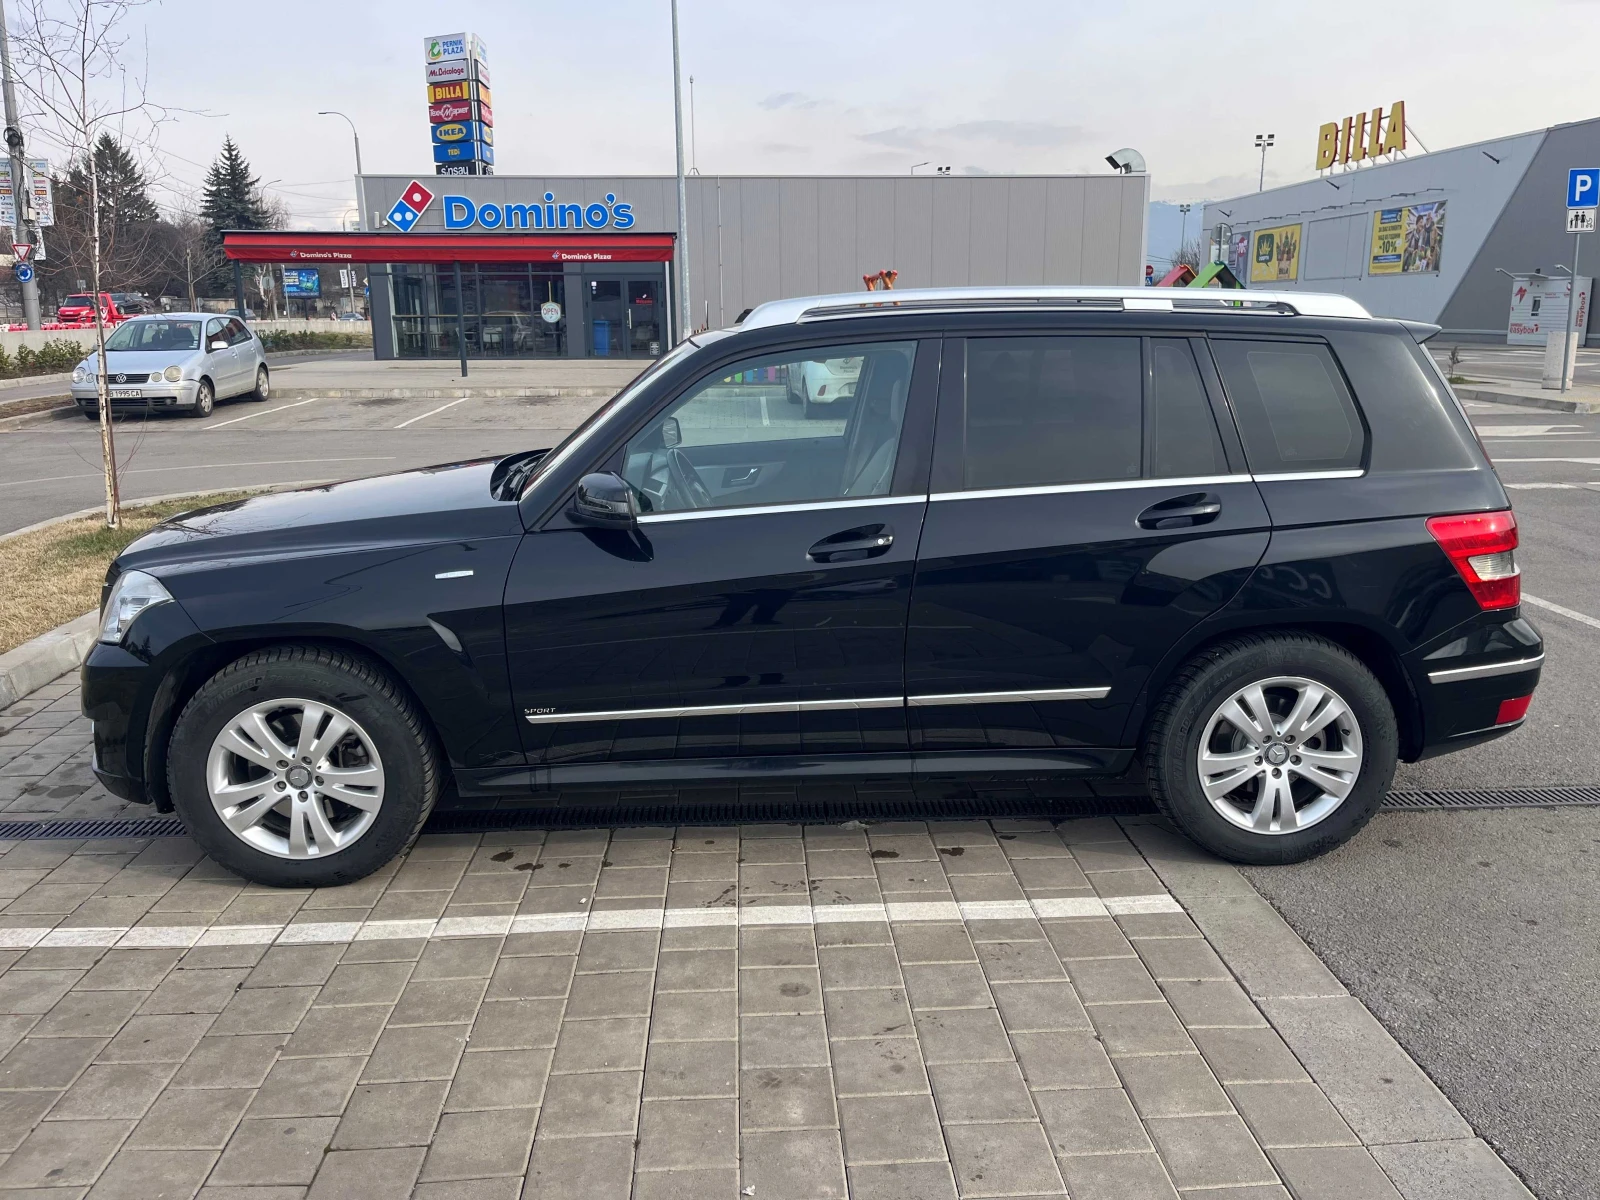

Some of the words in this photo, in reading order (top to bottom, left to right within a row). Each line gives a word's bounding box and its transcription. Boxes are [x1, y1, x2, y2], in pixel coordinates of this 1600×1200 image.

[442, 39, 463, 47] PERNIK
[443, 46, 464, 55] PLAZA
[435, 86, 462, 100] BILLA
[439, 128, 464, 137] IKEA
[1316, 101, 1405, 170] BILLA
[1575, 175, 1592, 201] P
[443, 191, 635, 230] Domino's
[1379, 240, 1397, 253] -10%
[543, 307, 559, 316] OPEN
[1578, 297, 1587, 328] easybox
[1510, 326, 1535, 335] easybox
